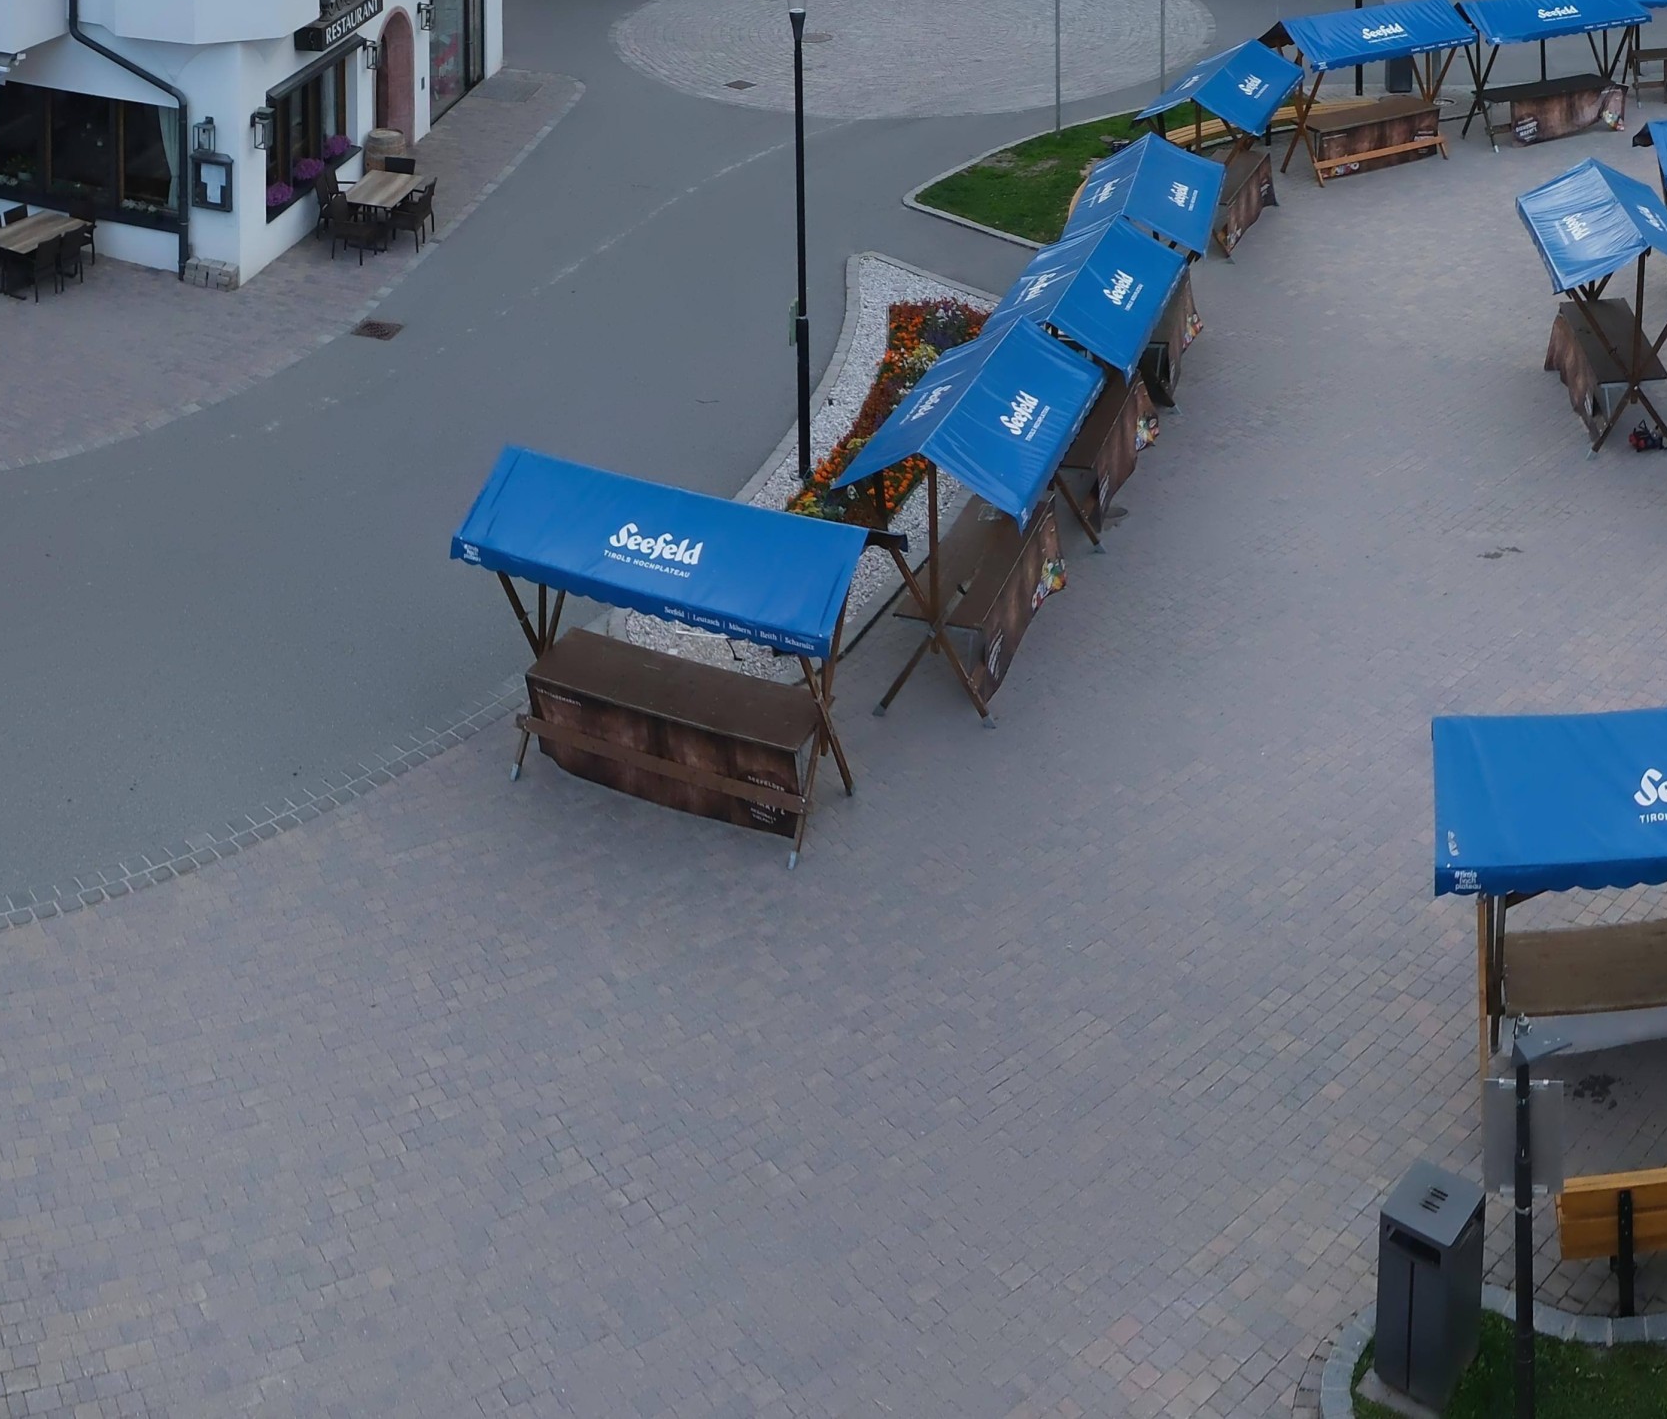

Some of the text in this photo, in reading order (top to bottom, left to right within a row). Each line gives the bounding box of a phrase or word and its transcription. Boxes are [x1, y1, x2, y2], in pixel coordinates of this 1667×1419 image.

[1537, 5, 1579, 19] Seefeld
[1362, 22, 1405, 40] Seefeld
[1238, 74, 1262, 96] Seefeld
[1167, 181, 1189, 208] Seefeld
[1103, 268, 1135, 307] Seefeld
[1000, 389, 1040, 436] Seefeld
[609, 522, 704, 566] Seefeld
[604, 549, 691, 578] TIROLS HOCHPLATEAU
[748, 775, 785, 793] SEEFELDER
